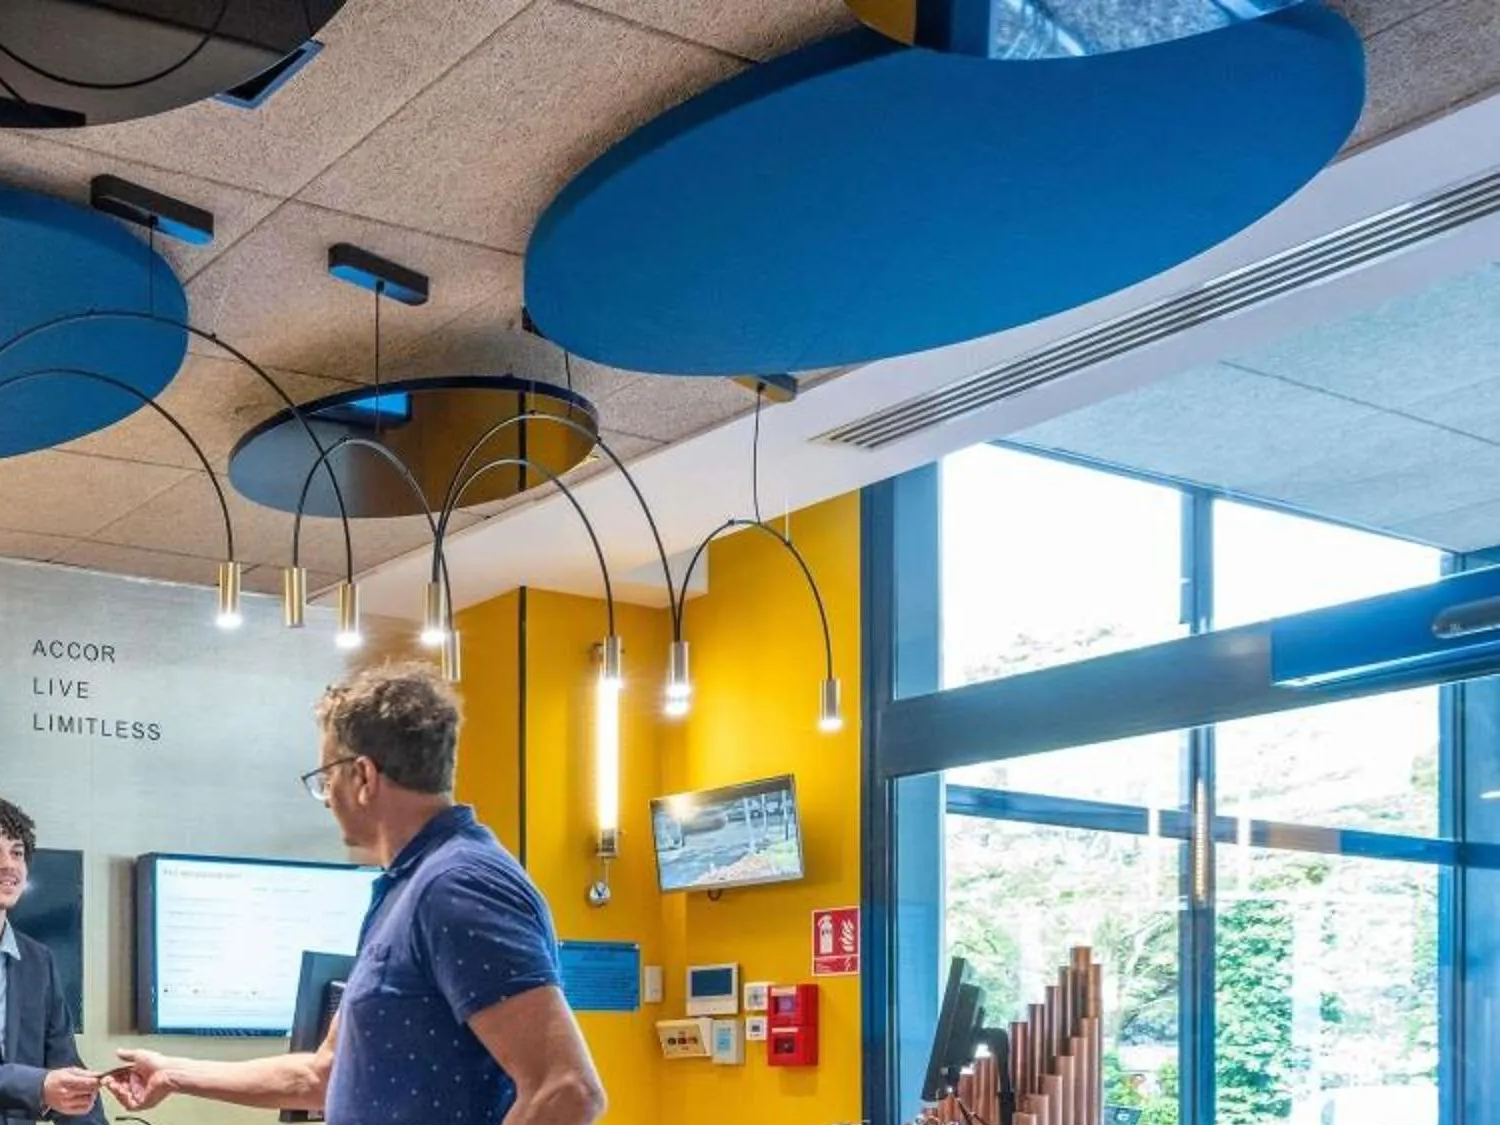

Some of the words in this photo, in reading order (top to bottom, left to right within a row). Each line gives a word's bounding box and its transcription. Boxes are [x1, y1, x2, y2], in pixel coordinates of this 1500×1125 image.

[32, 639, 116, 663] ACCOR
[33, 677, 90, 699] LIVE
[33, 712, 162, 741] LIMITLESS
